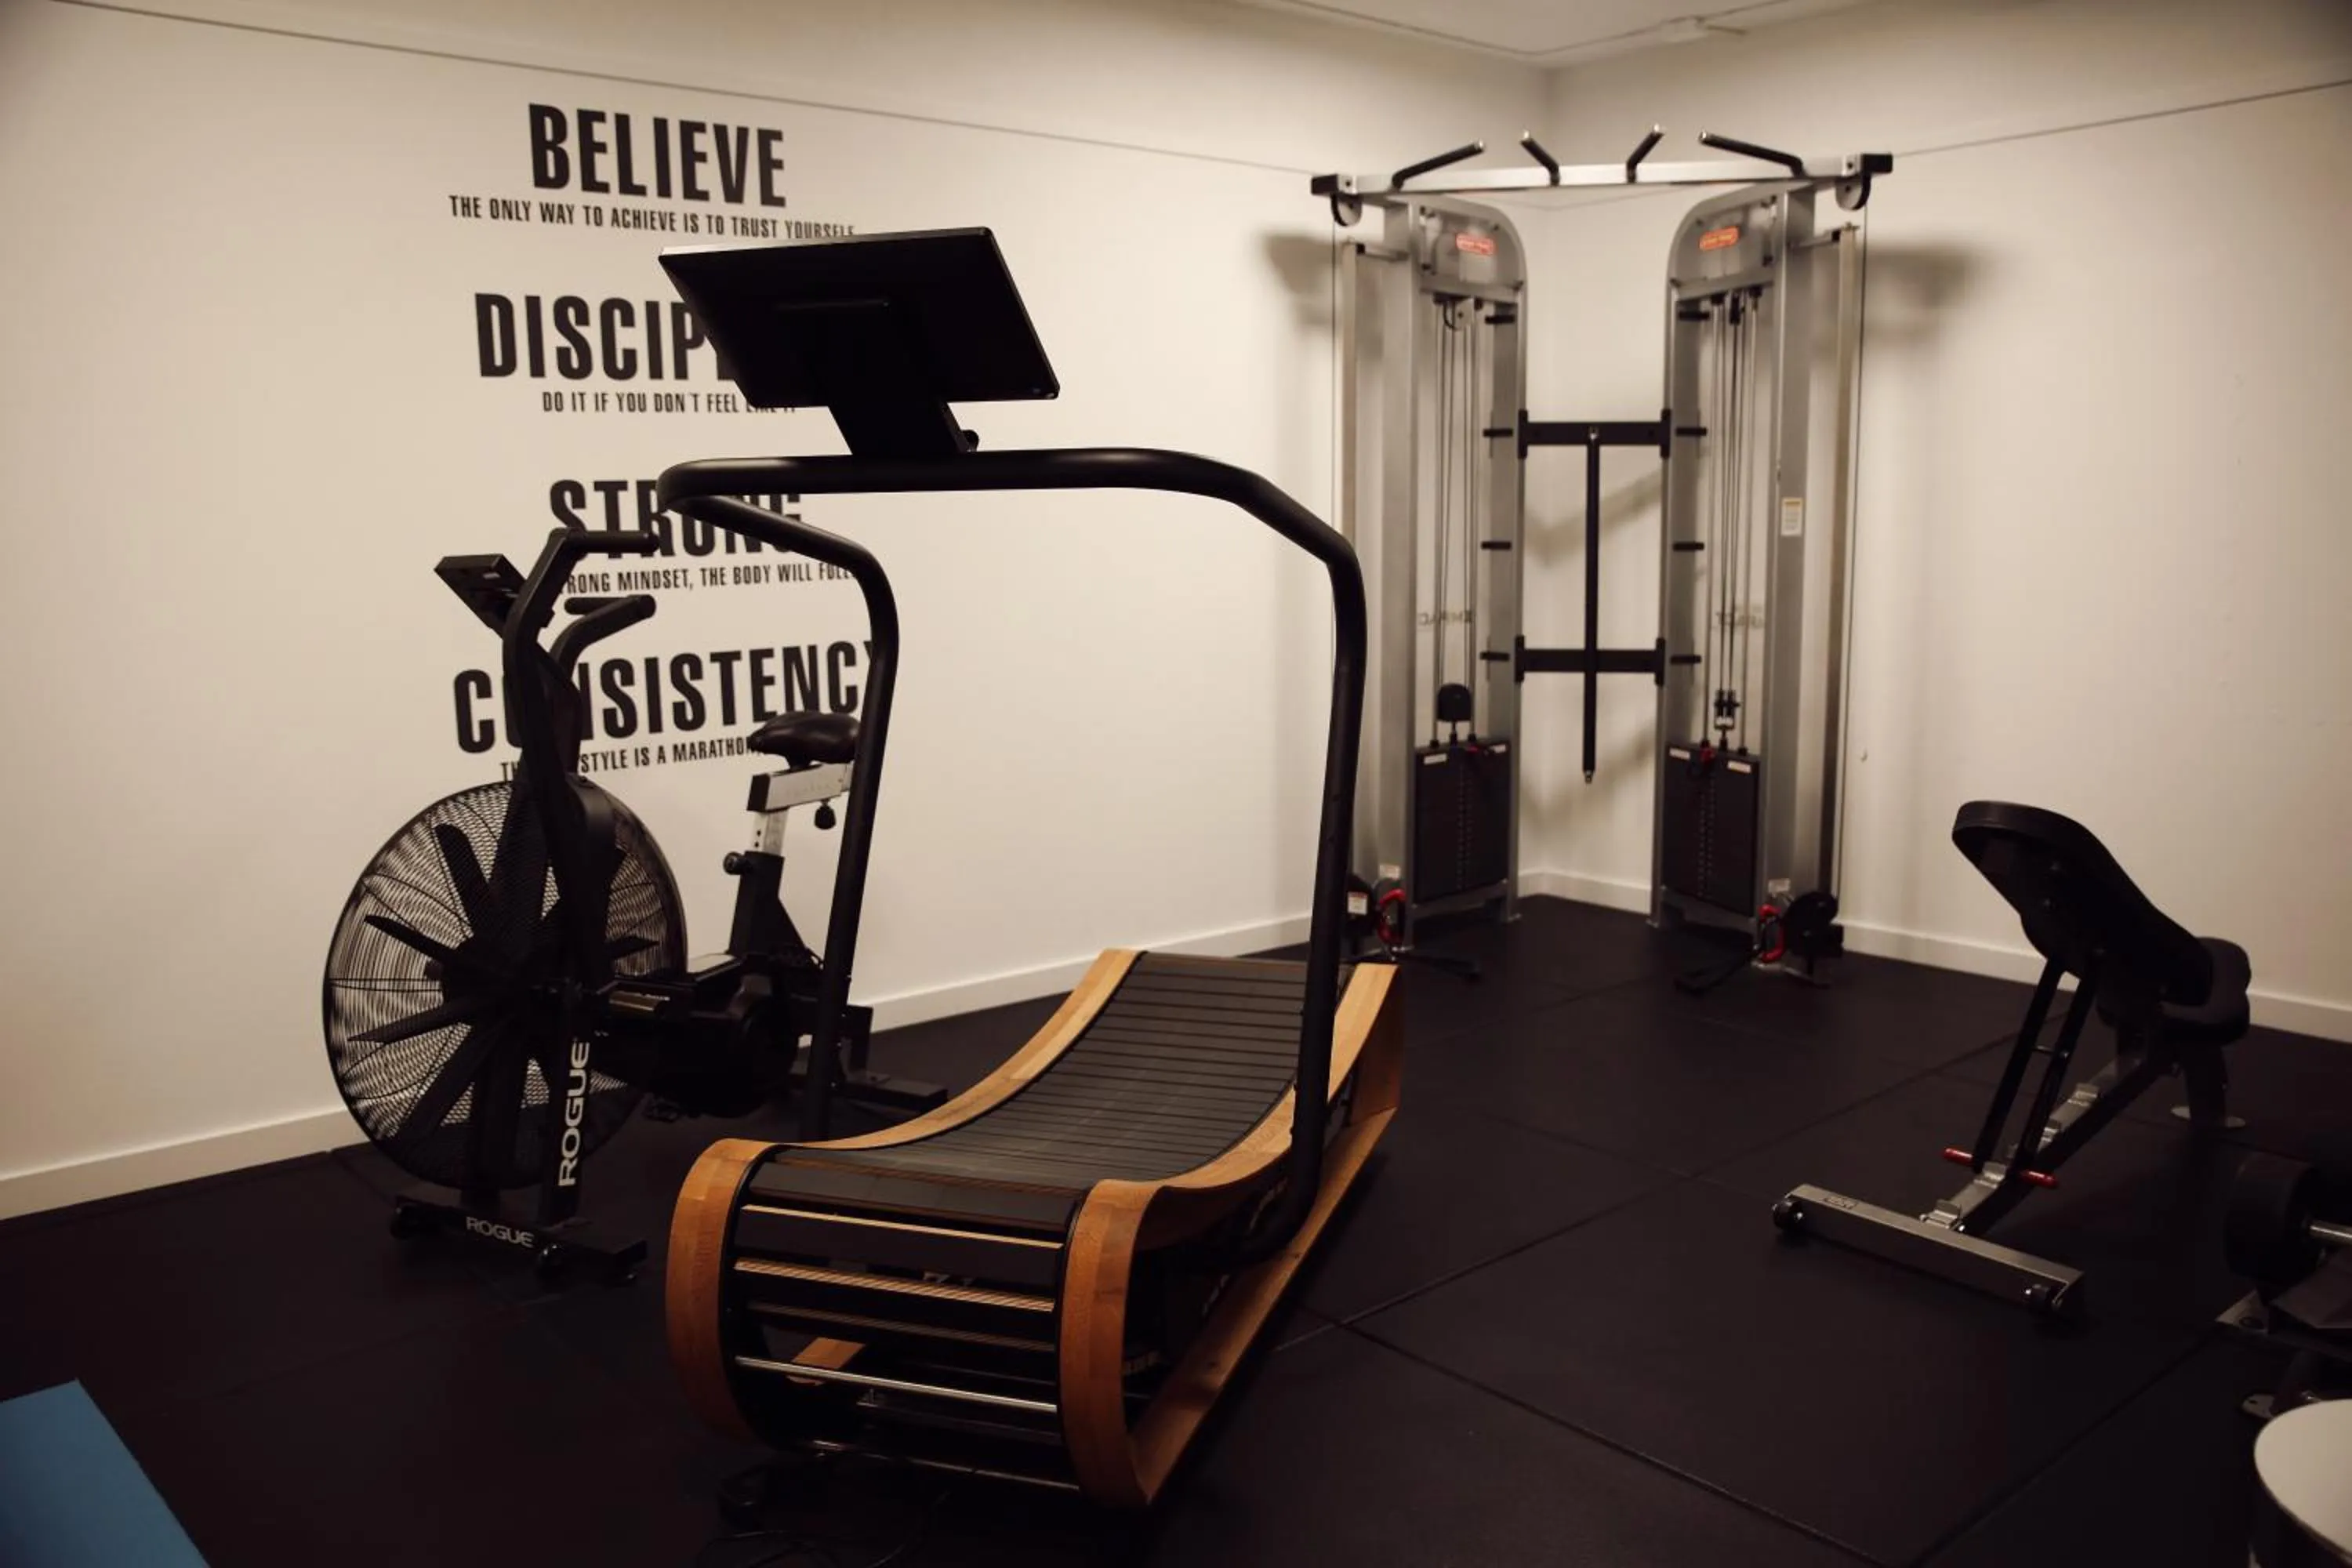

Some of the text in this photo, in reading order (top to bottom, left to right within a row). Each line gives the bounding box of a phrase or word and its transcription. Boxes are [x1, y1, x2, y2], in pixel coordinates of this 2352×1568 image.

[528, 103, 787, 208] BELIEVE
[449, 195, 481, 219] THE
[489, 198, 531, 222] ONLY
[539, 201, 575, 225] WAY
[583, 205, 603, 227] TO
[611, 208, 676, 233] ACHIEVE
[683, 212, 699, 233] IS
[706, 214, 724, 235] TO
[731, 216, 779, 238] TRUST
[475, 292, 735, 381] DISCIP
[543, 391, 564, 412] DO
[572, 392, 586, 412] IT
[594, 392, 609, 412] IF
[617, 392, 647, 412] YOU
[707, 393, 739, 414] FEEL
[561, 572, 610, 595] RONG
[618, 568, 694, 591] MINDSET,
[700, 567, 726, 586] THE
[733, 564, 771, 586] BODY
[778, 562, 812, 583] WILL
[579, 749, 628, 774] STYLE
[634, 746, 651, 767] IS
[656, 744, 666, 764] A
[673, 735, 751, 763] MARATHO
[558, 1041, 590, 1186] ROGUE
[466, 1216, 535, 1248] ROGUE
